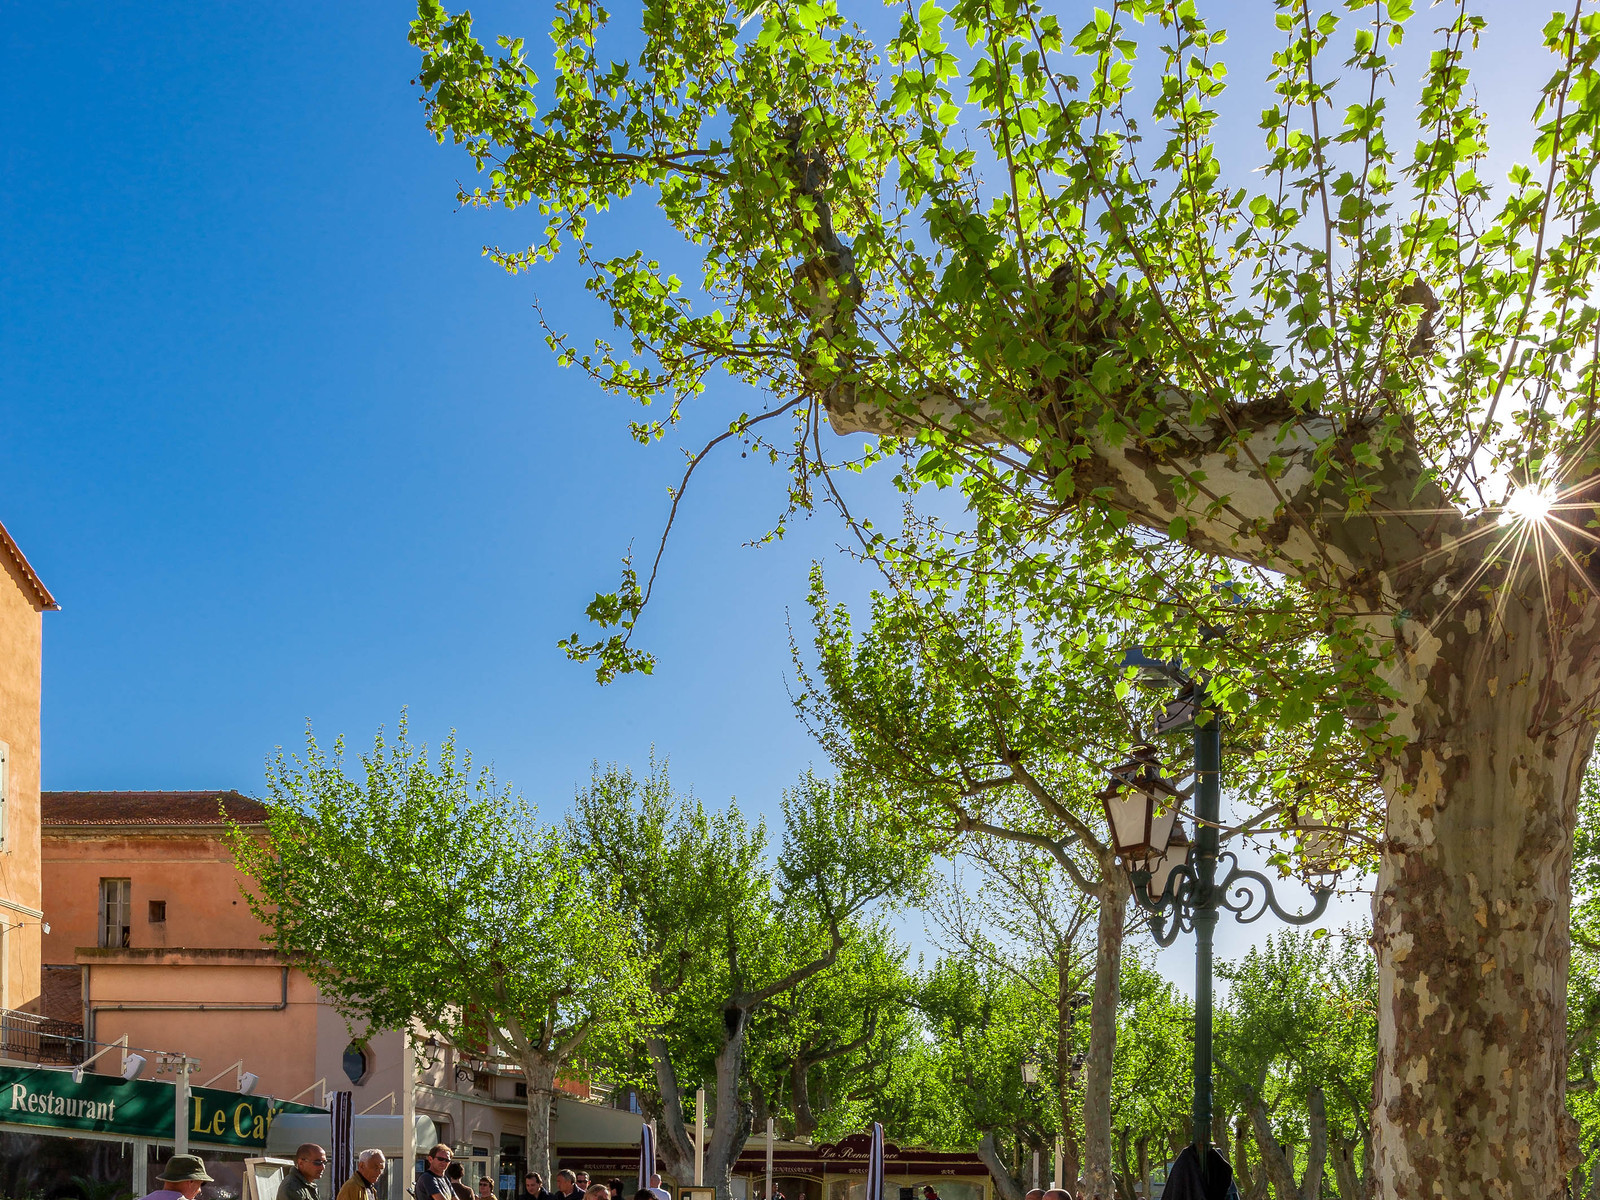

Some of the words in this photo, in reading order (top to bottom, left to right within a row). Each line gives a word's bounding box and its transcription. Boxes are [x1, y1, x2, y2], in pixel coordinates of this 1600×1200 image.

[10, 1083, 116, 1121] Restaurant
[191, 1096, 226, 1135] Le
[234, 1103, 283, 1139] Caf
[819, 1147, 836, 1158] La
[838, 1146, 899, 1159] Renaince
